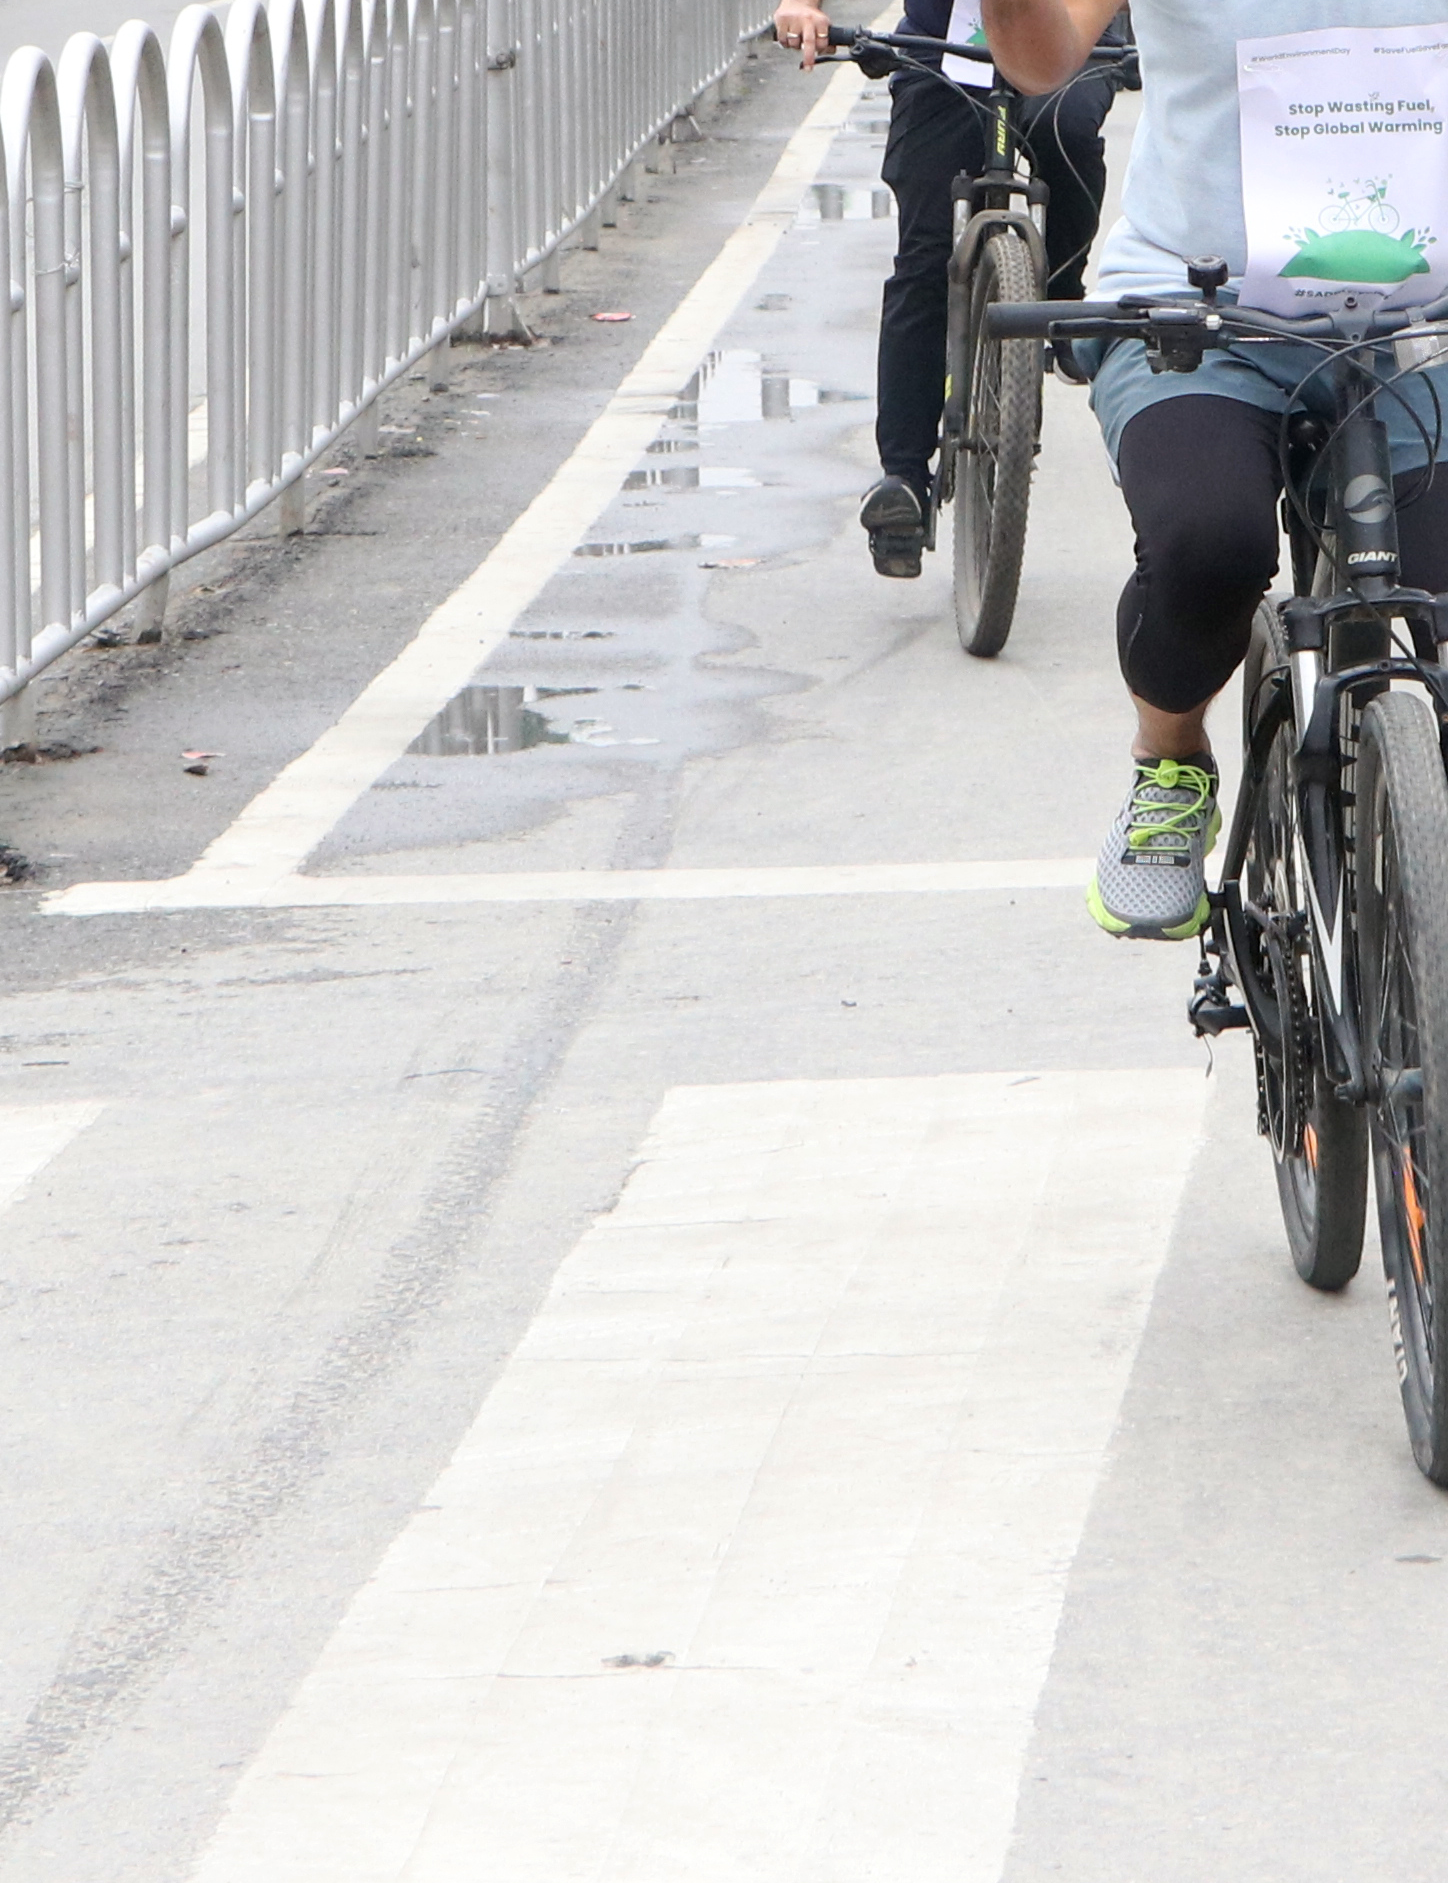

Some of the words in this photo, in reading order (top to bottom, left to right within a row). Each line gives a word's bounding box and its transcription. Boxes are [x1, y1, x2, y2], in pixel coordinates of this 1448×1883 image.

[1288, 103, 1325, 117] Stop
[1327, 100, 1395, 115] Wasting
[1397, 99, 1435, 113] Fuel,
[1274, 124, 1311, 139] Stop
[1313, 121, 1365, 135] Global
[1368, 118, 1444, 135] Warming
[1347, 550, 1397, 565] GIANT
